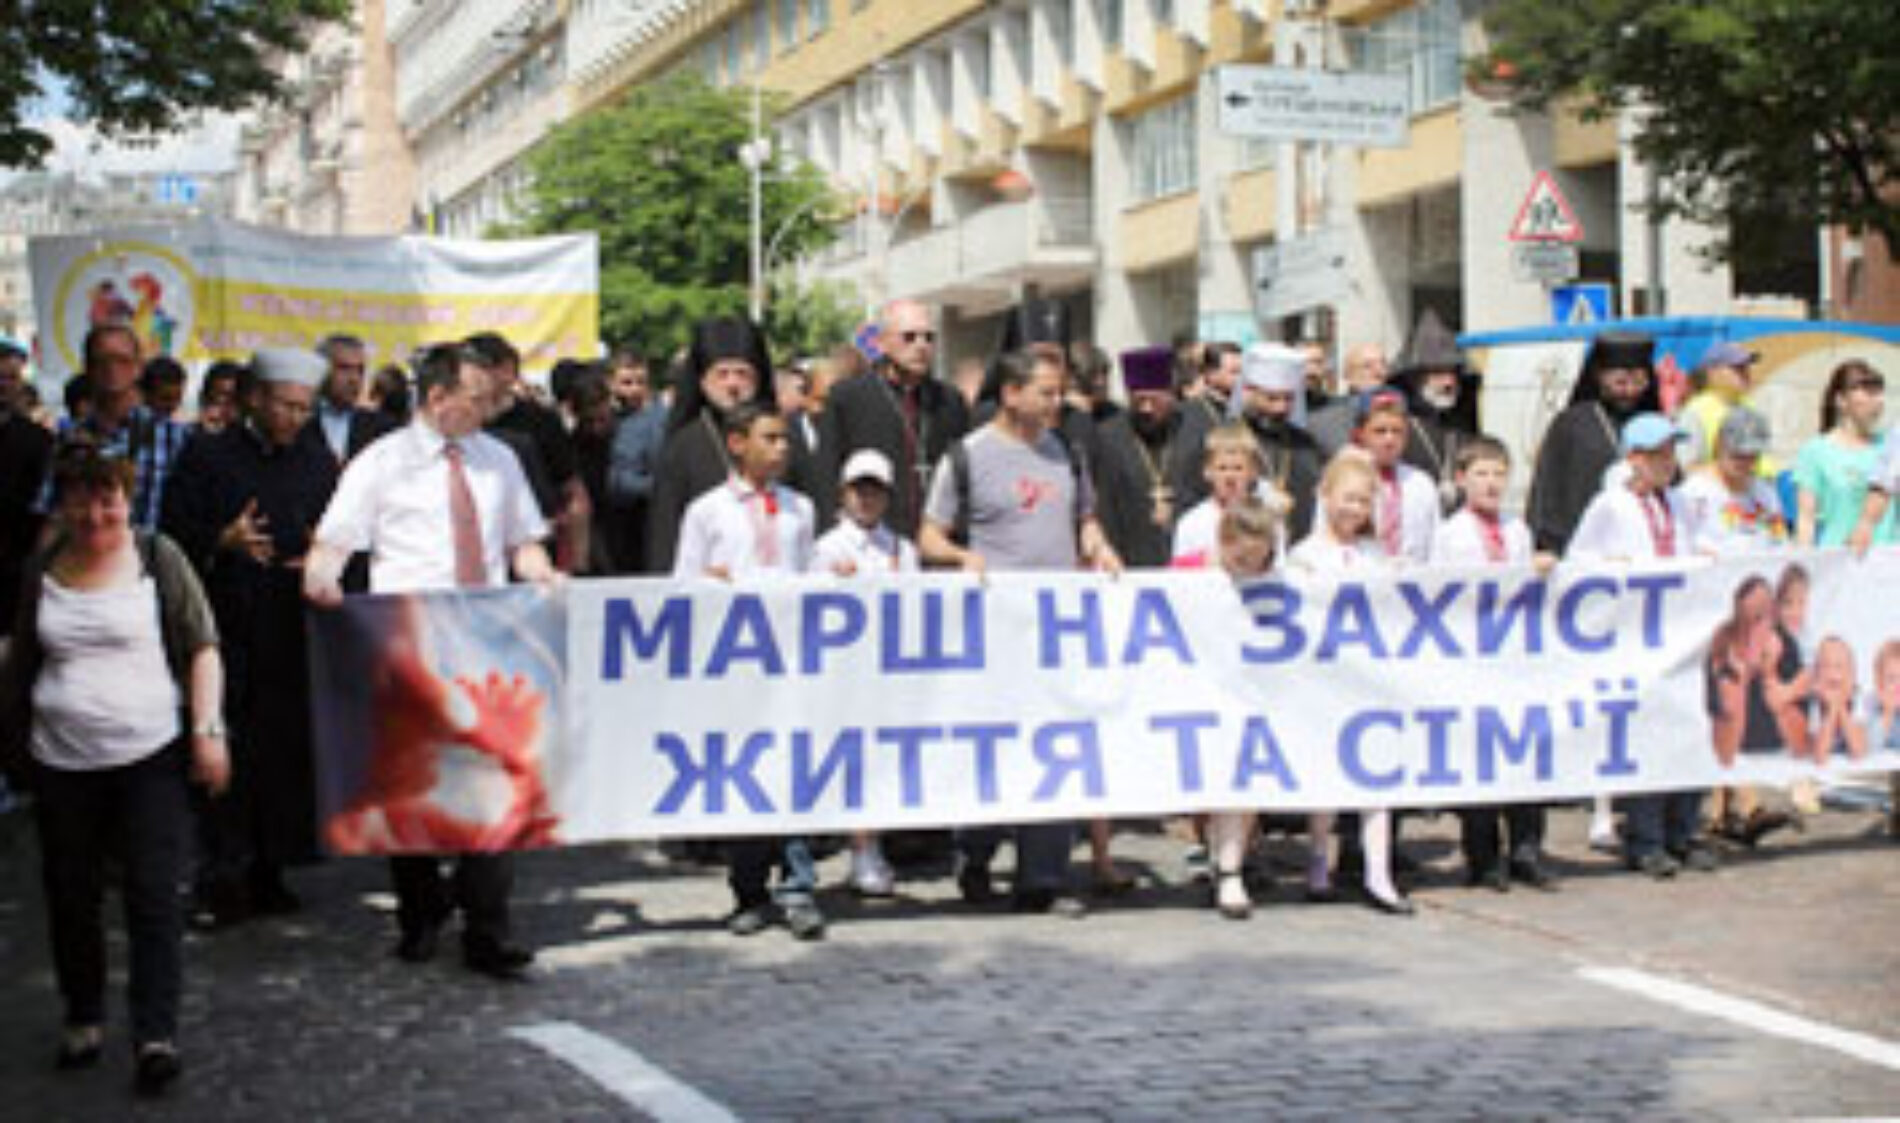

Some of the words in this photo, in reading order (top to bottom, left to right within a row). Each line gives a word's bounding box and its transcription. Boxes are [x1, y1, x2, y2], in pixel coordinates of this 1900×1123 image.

[600, 590, 986, 680] МАРШ
[1038, 587, 1196, 668] НА
[1240, 574, 1685, 664] ЗАХИСТ
[652, 720, 1108, 814] ЖИТТЯ
[1148, 711, 1299, 791] ТА
[1336, 678, 1640, 790] СІМ'Ї
